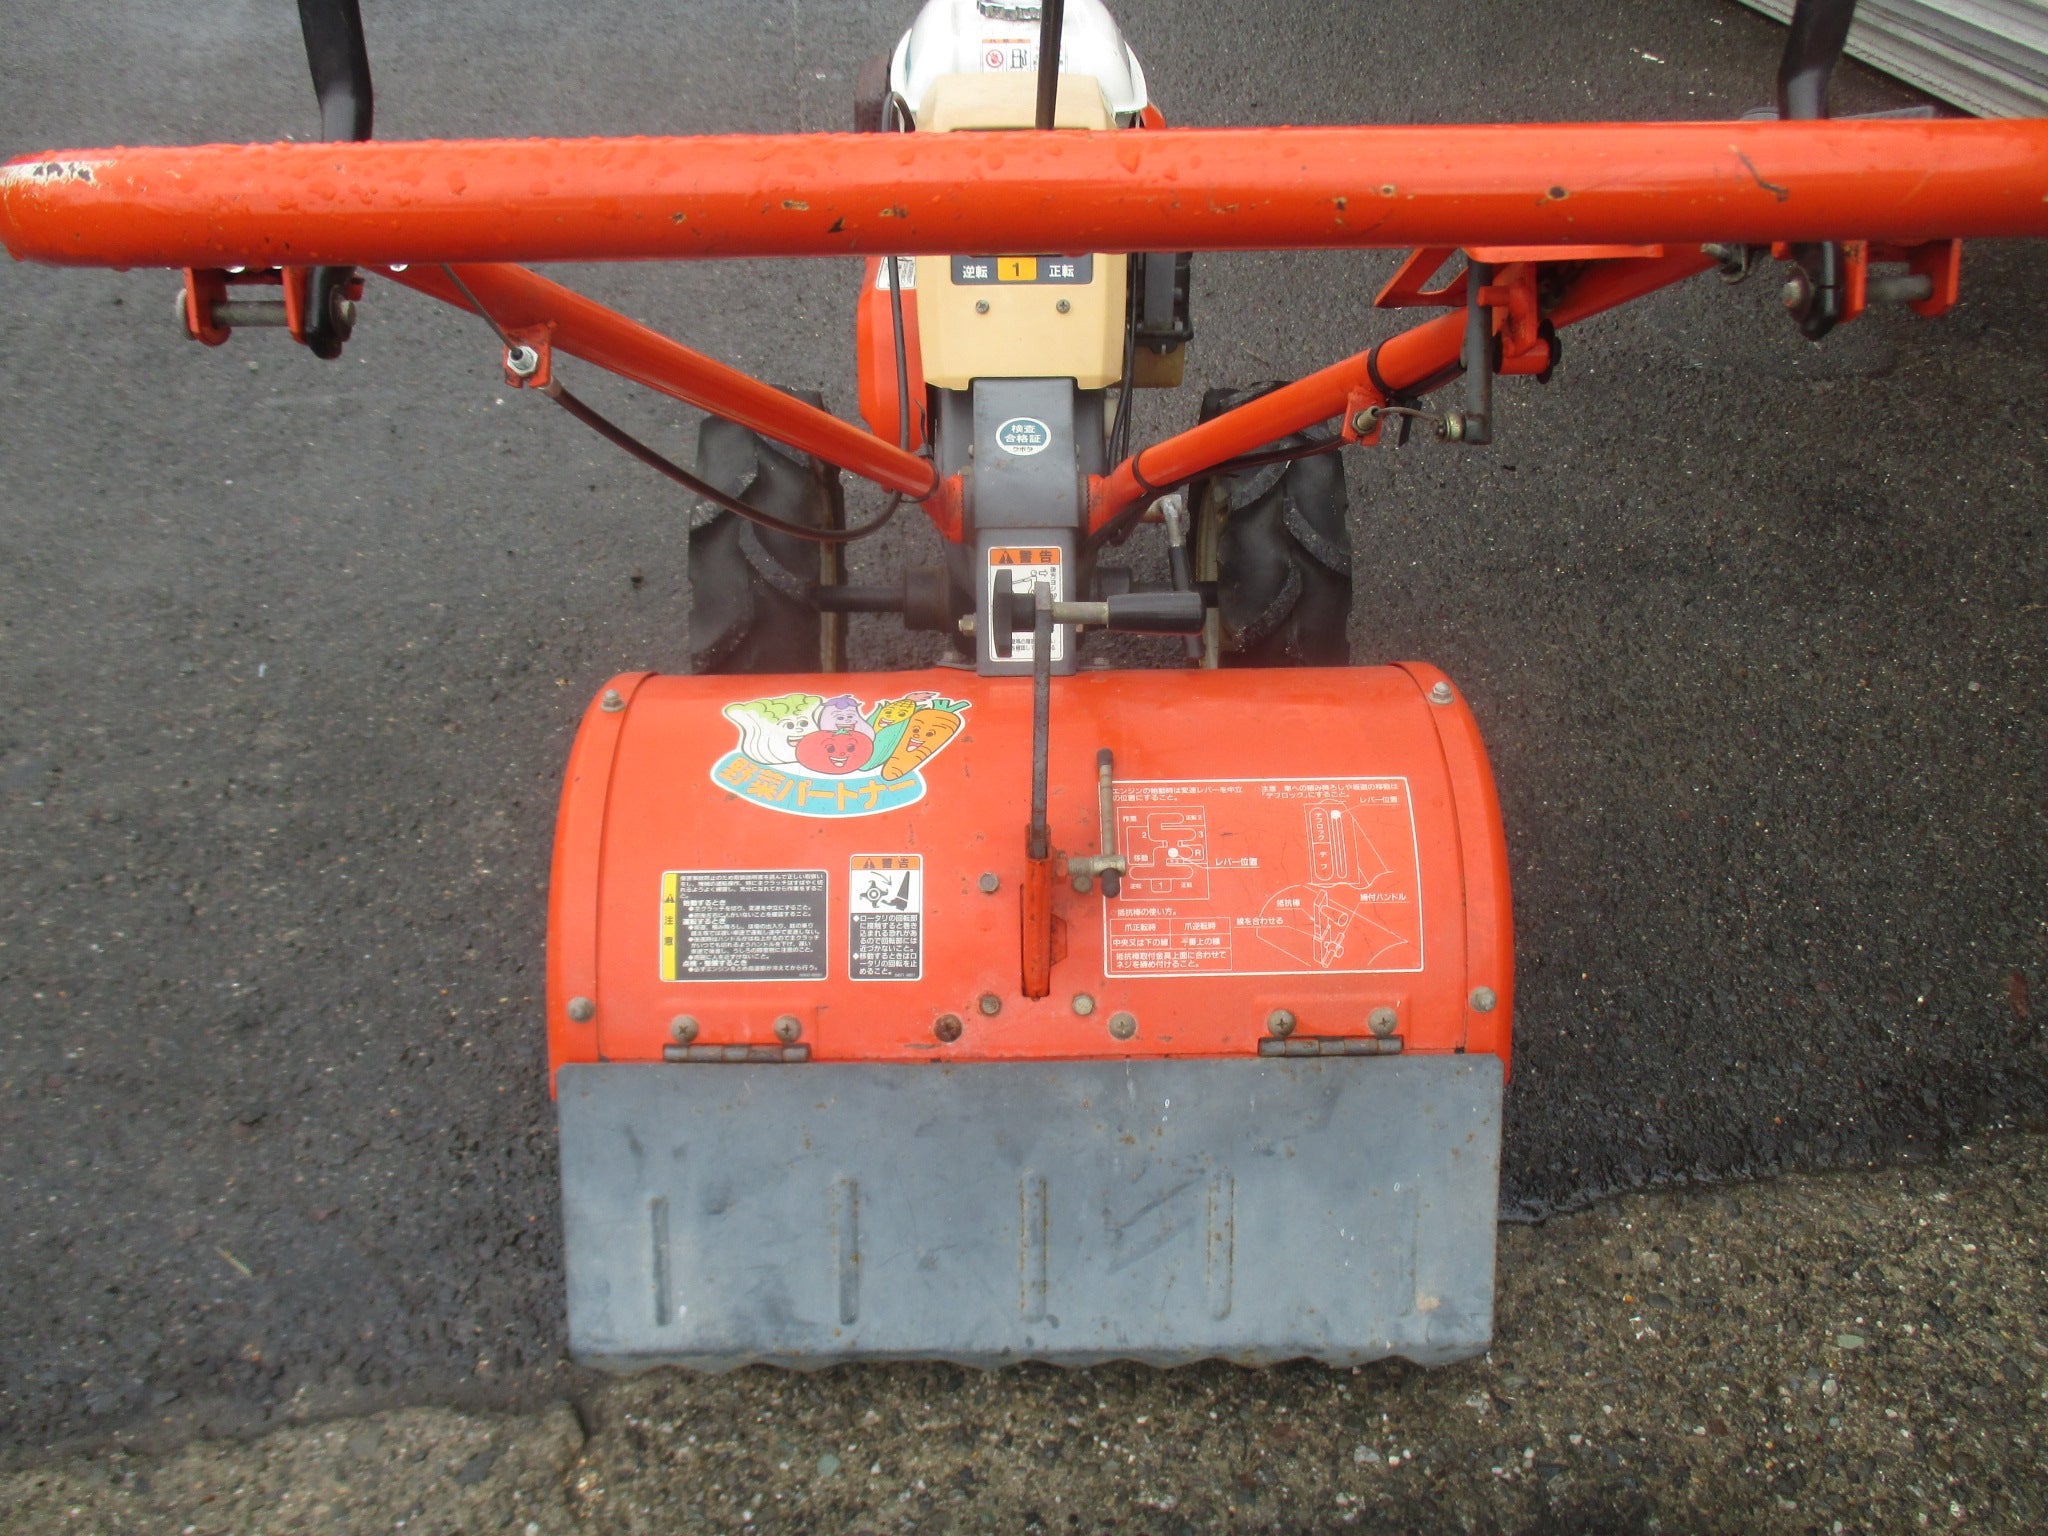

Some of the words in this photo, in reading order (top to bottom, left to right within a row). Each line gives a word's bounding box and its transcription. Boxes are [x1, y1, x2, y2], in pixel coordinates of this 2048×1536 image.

[962, 265, 988, 279] 逆転
[1011, 263, 1020, 277] 1
[1048, 265, 1075, 278] 正転
[1011, 424, 1036, 433] 検査
[1005, 433, 1041, 443] 合格証
[1019, 550, 1053, 563] 警告
[718, 756, 916, 810] 野菜パートナー
[1215, 857, 1258, 866] レバー位置
[1236, 917, 1284, 925] 線を合わせる
[1125, 923, 1157, 932] 爪正転時
[1184, 922, 1217, 930] 爪逆転時
[860, 944, 914, 952] 近づかないこと。
[860, 952, 918, 960] 移動するときはロ
[860, 959, 918, 968] ータリの回転を止
[859, 967, 892, 975] めること。
